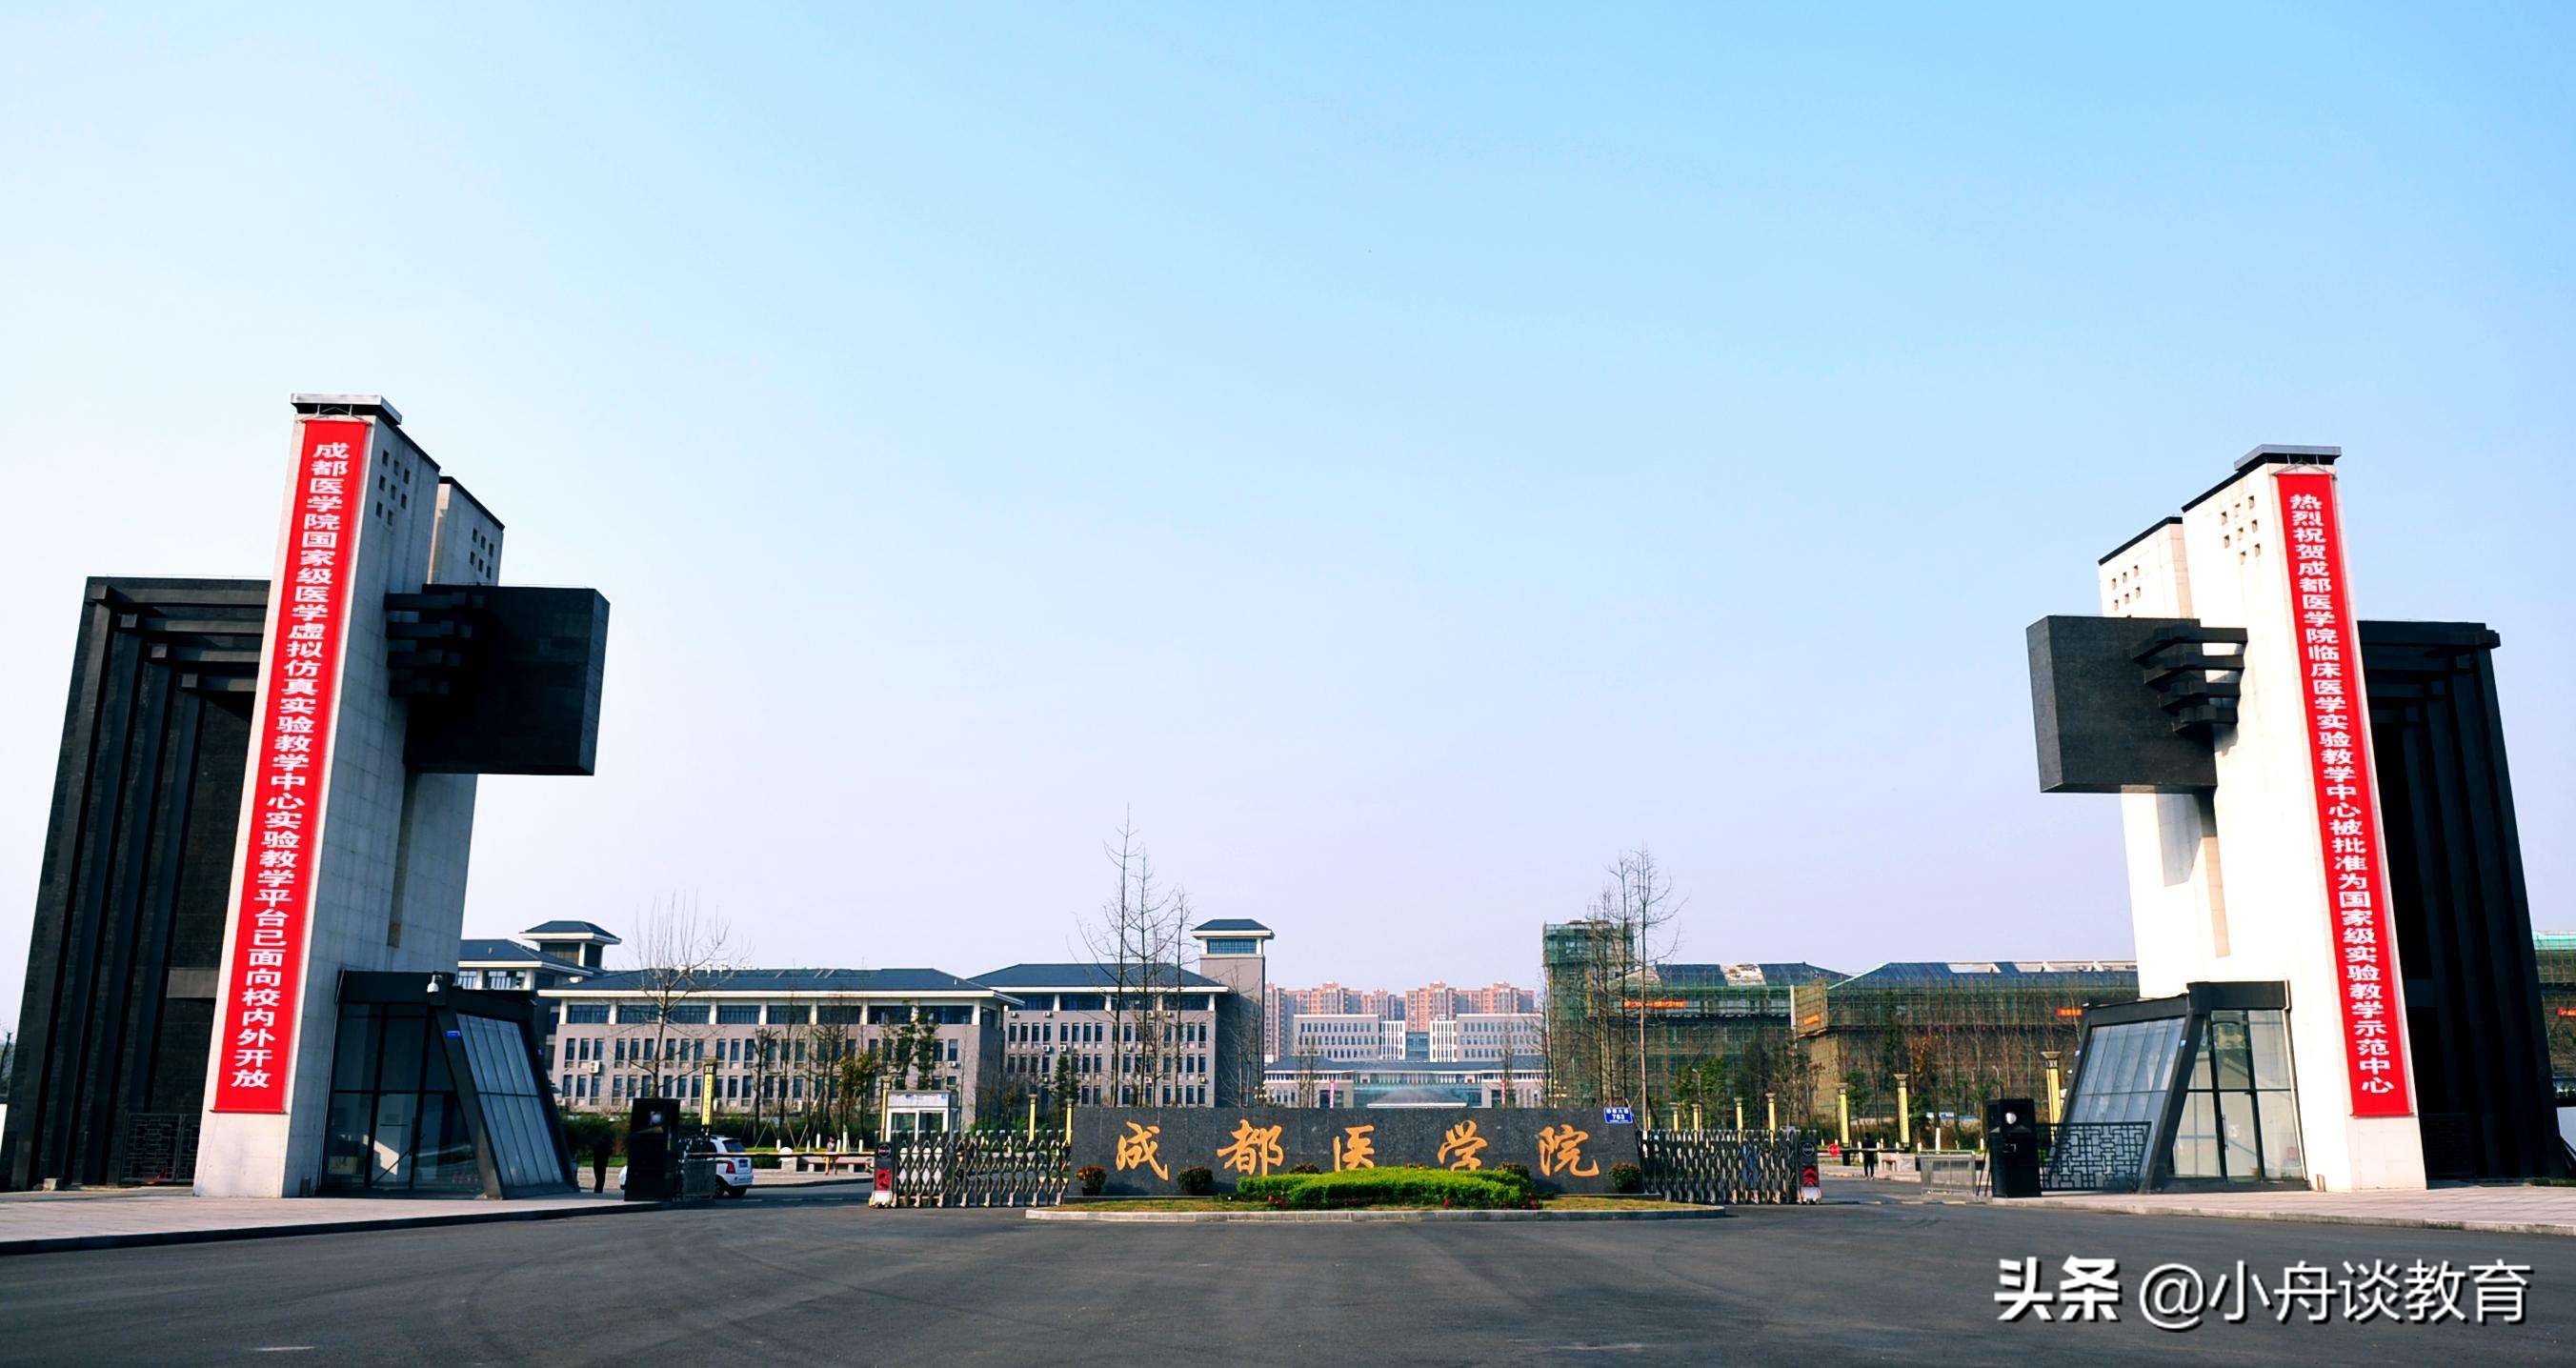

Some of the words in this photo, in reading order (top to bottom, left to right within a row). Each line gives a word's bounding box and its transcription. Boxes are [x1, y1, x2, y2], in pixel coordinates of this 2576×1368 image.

[231, 441, 350, 1089] 成都医学院国家级医学虚拟仿真实验教学中心实验教学平台已面向校内外开放
[2289, 493, 2395, 1094] 热烈祝贺成都医学院临床医学实验教学中心被批准为国家级实验教学示范中心
[1117, 1120, 1598, 1179] 成都医学院
